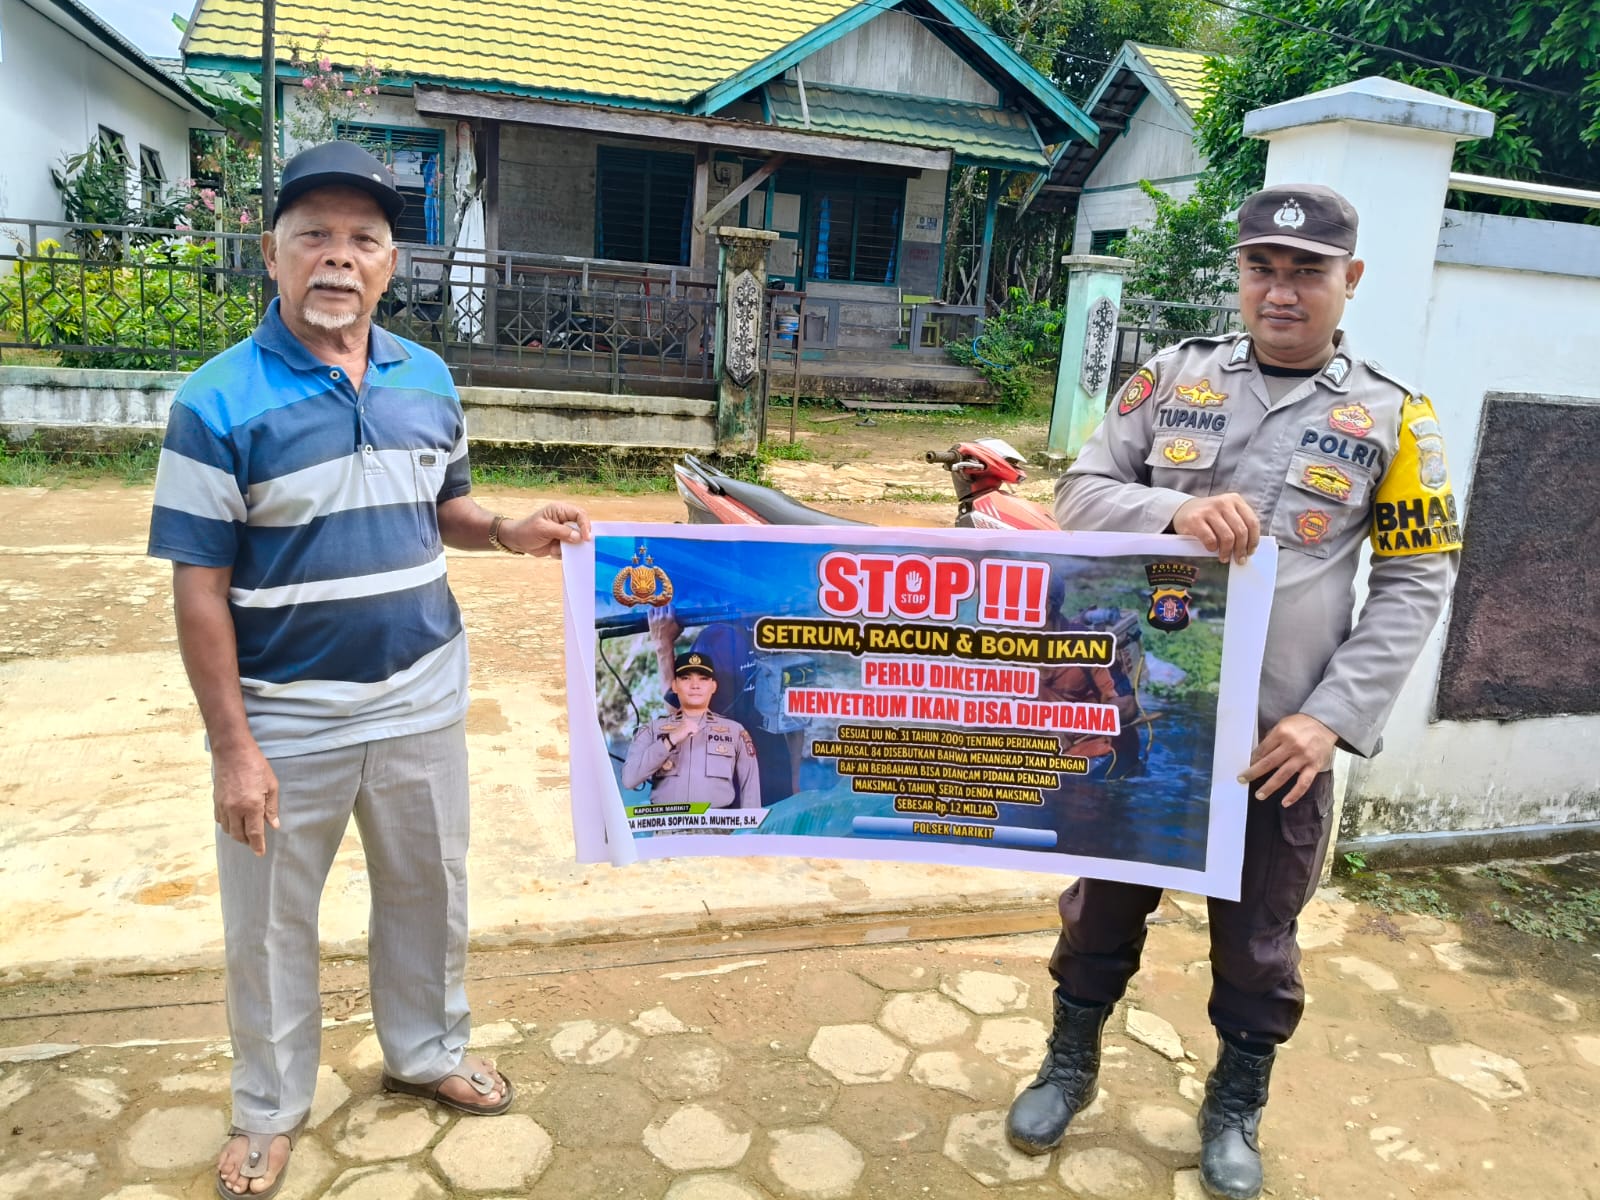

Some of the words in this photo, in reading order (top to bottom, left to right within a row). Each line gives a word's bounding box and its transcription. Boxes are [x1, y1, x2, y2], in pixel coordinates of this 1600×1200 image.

[1159, 408, 1227, 432] TUPANG
[1300, 428, 1378, 468] POLRI
[824, 556, 970, 616] STOP
[983, 563, 1044, 623] !!!
[900, 593, 926, 605] STOP
[761, 624, 861, 650] SETRUM,
[869, 629, 949, 651] RACUN
[956, 633, 973, 654] &
[981, 635, 1039, 658] BOM
[1047, 639, 1107, 660] IKAN
[864, 661, 925, 688] PERLU
[930, 664, 1036, 695] DIKETAHUI
[788, 690, 907, 718] MENYETRUM
[912, 695, 960, 721] IKAN
[963, 700, 1013, 725] BISA
[1016, 702, 1117, 733] DIPIDANA
[707, 733, 733, 743] POLRI
[840, 727, 870, 739] SESUAI
[871, 729, 883, 740] UU
[885, 729, 899, 740] No.
[901, 730, 910, 741] 31
[912, 730, 939, 742] TAHUN
[941, 732, 964, 745] 2009
[966, 736, 1005, 751] TENTANG
[1006, 738, 1058, 753] PERIKANAN,
[814, 743, 842, 755] DALAM
[844, 745, 869, 757] PASAL
[871, 746, 881, 757] 84
[883, 747, 936, 760] DISEBUTKAN
[937, 750, 968, 763] BAHWA
[970, 752, 1024, 766] MENANGKAP
[1024, 755, 1047, 769] IKAN
[1049, 757, 1086, 771] DENGAN
[870, 762, 919, 776] BERBAHAYA
[920, 765, 941, 777] BISA
[942, 767, 980, 780] DIANCAM
[982, 770, 1015, 783] PIDANA
[1017, 772, 1057, 787] PENJARA
[854, 778, 898, 792] MAKSIMAL
[899, 781, 906, 792] 6
[938, 784, 964, 797] SERTA
[965, 787, 994, 799] DENDA
[995, 788, 1041, 803] MAKSIMAL
[634, 806, 664, 815] KAPOLSEK
[665, 804, 690, 813] MARIKIT
[897, 798, 933, 811] SEBESAR
[963, 803, 996, 817] MILIAR.
[637, 818, 666, 829] HENDRA
[668, 816, 699, 827] SOPIYAN
[701, 816, 708, 826] D.
[709, 816, 742, 826] MUNTHE,
[743, 816, 758, 825] S.H.
[913, 822, 950, 836] POLSEK
[952, 824, 995, 839] MARIKIT
